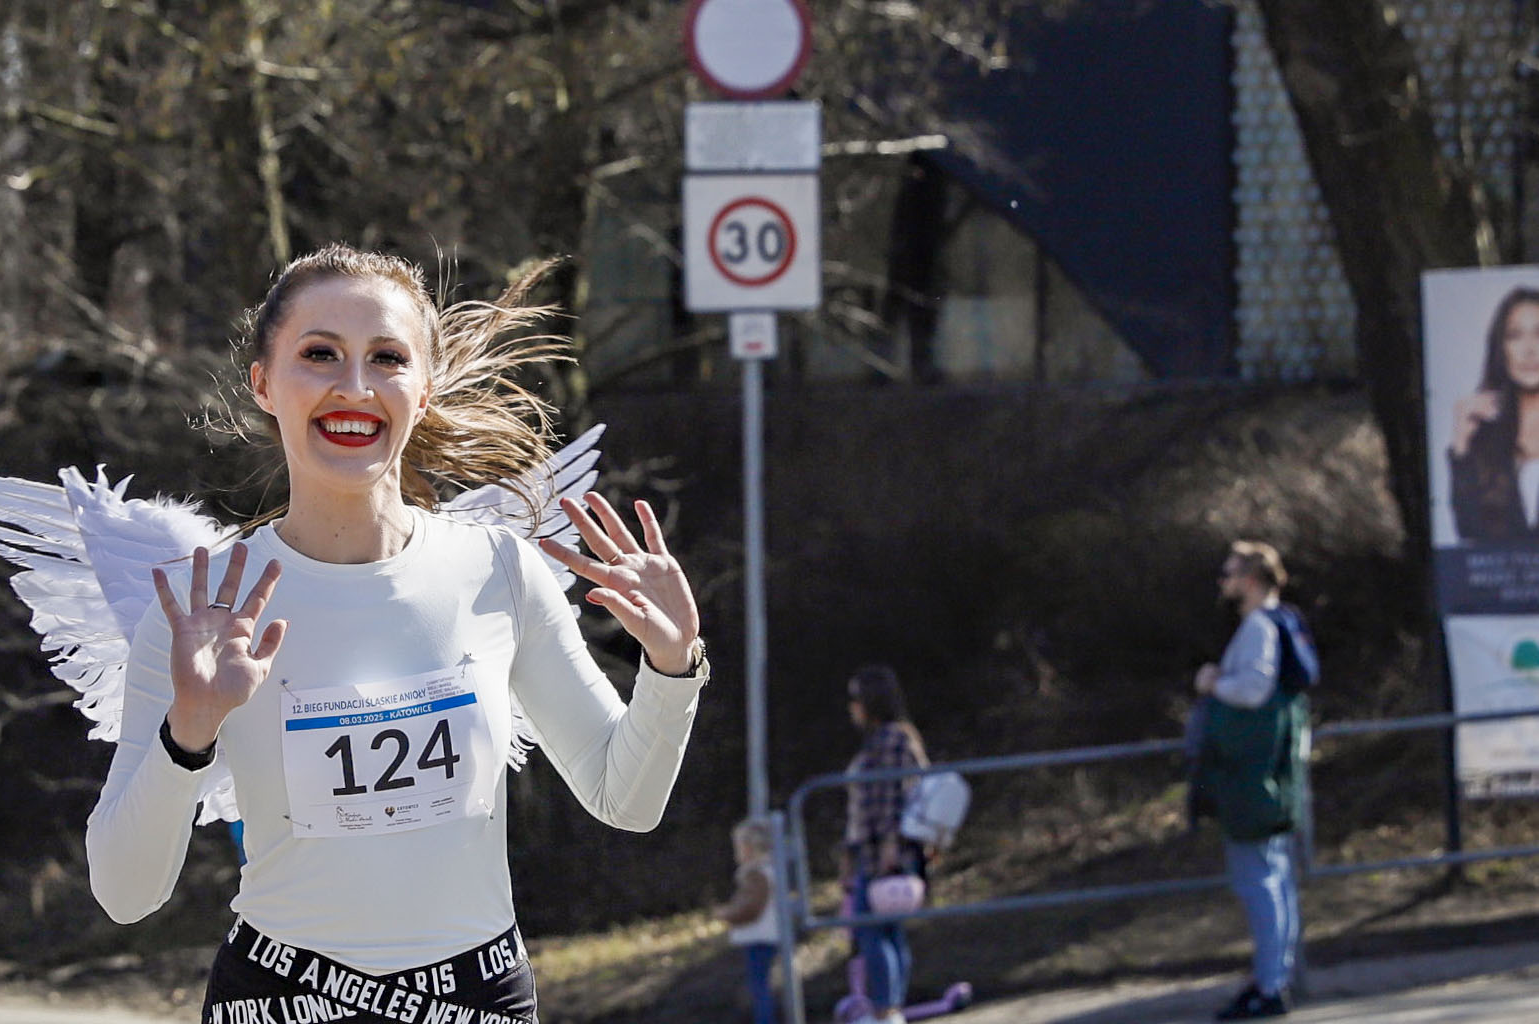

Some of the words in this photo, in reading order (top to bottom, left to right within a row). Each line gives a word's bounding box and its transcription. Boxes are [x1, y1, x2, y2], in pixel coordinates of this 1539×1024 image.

[723, 220, 784, 264] 30
[292, 704, 304, 714] 12.
[304, 702, 323, 713] BIEG
[324, 698, 365, 712] FUNDACJI
[365, 693, 398, 709] ŚLĄSKIE
[399, 688, 426, 705] ANIOŁY
[339, 713, 384, 726] 08.03.2025
[389, 704, 433, 721] KATOWICE
[325, 719, 461, 796] 124
[247, 933, 297, 977] LOS
[298, 957, 423, 1024] ANGELES
[477, 938, 516, 981] LOS
